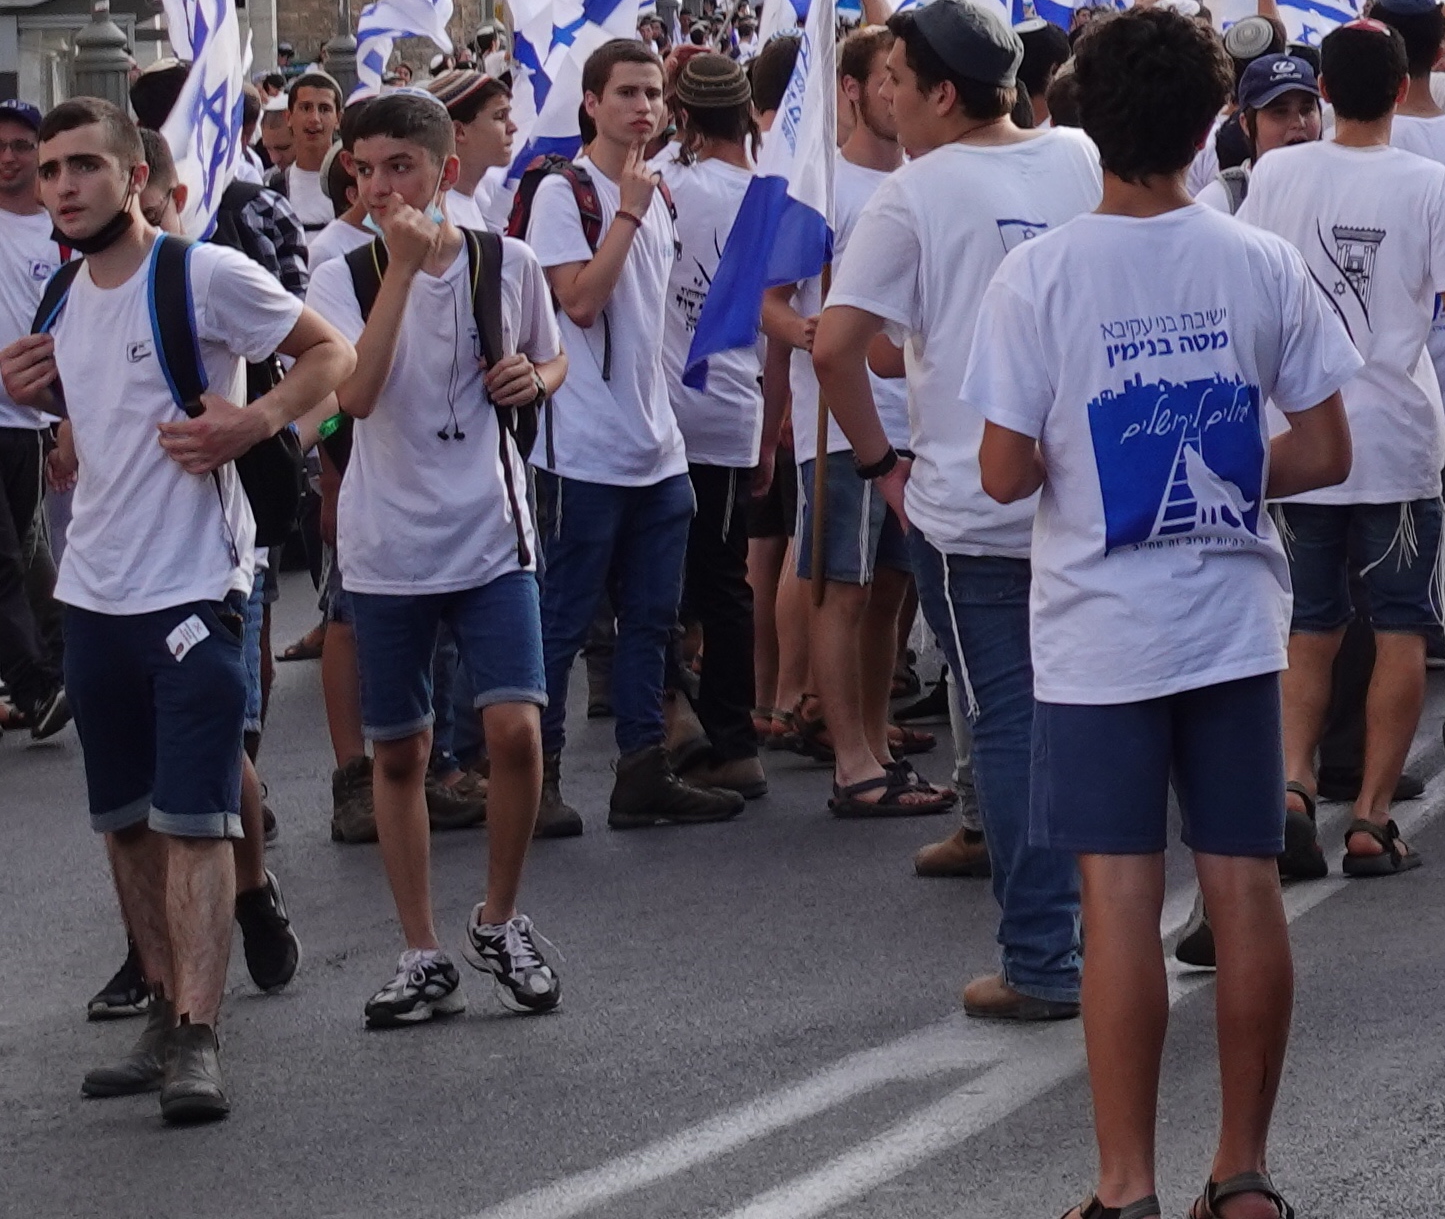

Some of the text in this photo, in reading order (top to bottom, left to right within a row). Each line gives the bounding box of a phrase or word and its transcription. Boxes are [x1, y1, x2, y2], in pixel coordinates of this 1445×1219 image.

[1100, 307, 1227, 342] ישיבת בני עקיבא
[1106, 329, 1229, 369] מטה בנימין
